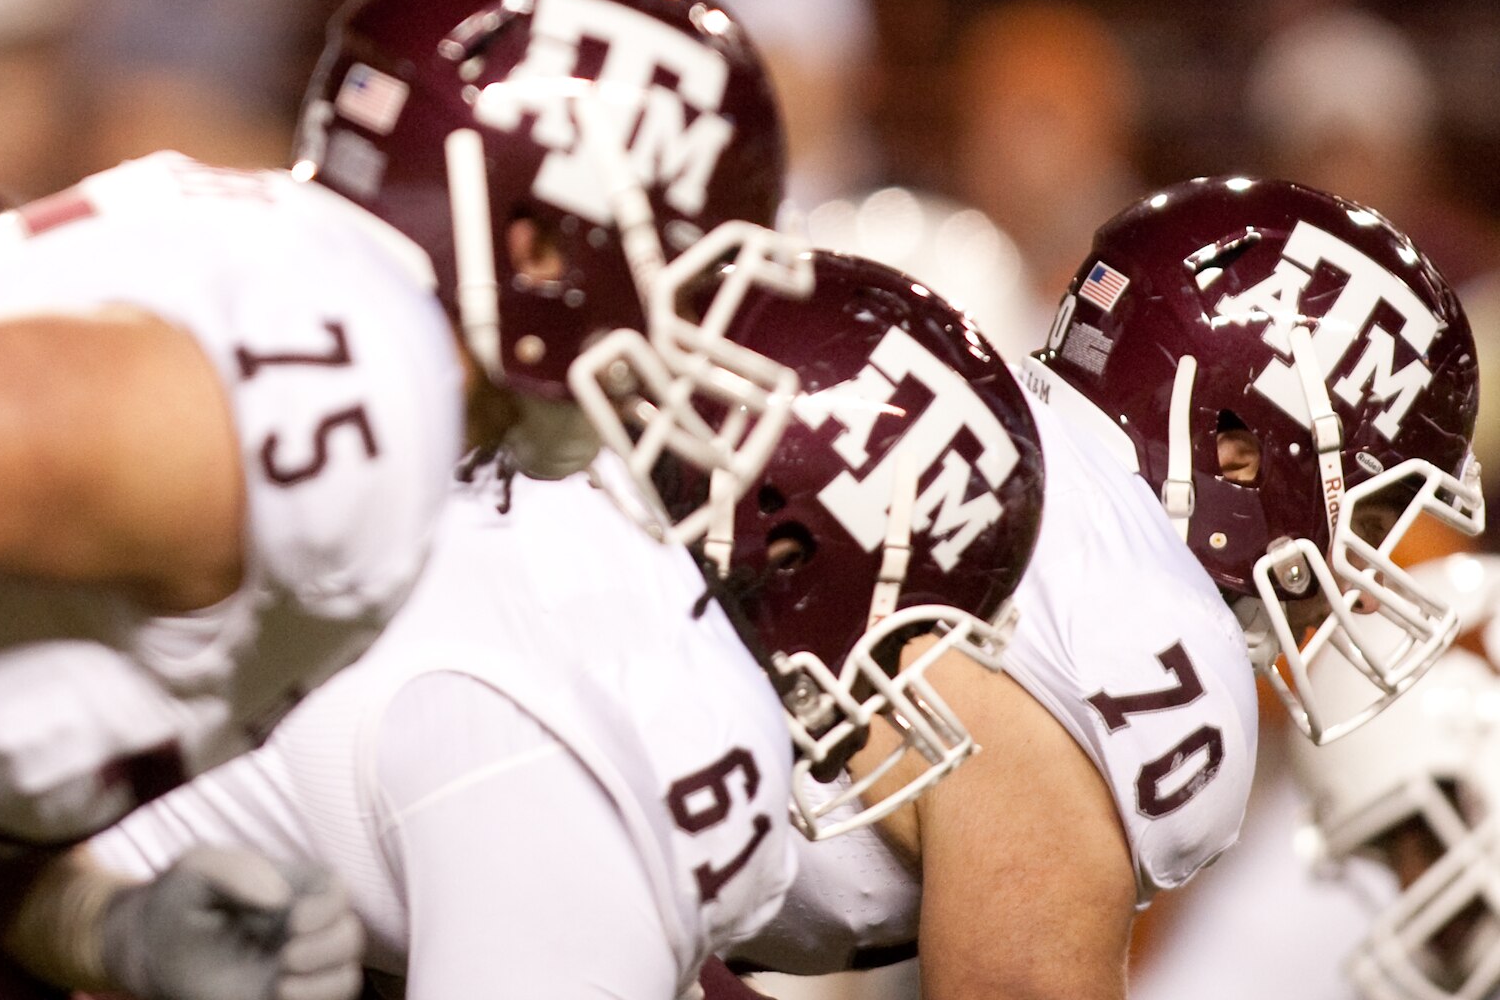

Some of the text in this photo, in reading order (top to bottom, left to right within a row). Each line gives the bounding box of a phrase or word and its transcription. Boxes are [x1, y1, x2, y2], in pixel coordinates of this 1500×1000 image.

[235, 318, 379, 488] 75
[1085, 640, 1225, 821] 70
[666, 746, 772, 903] 61
